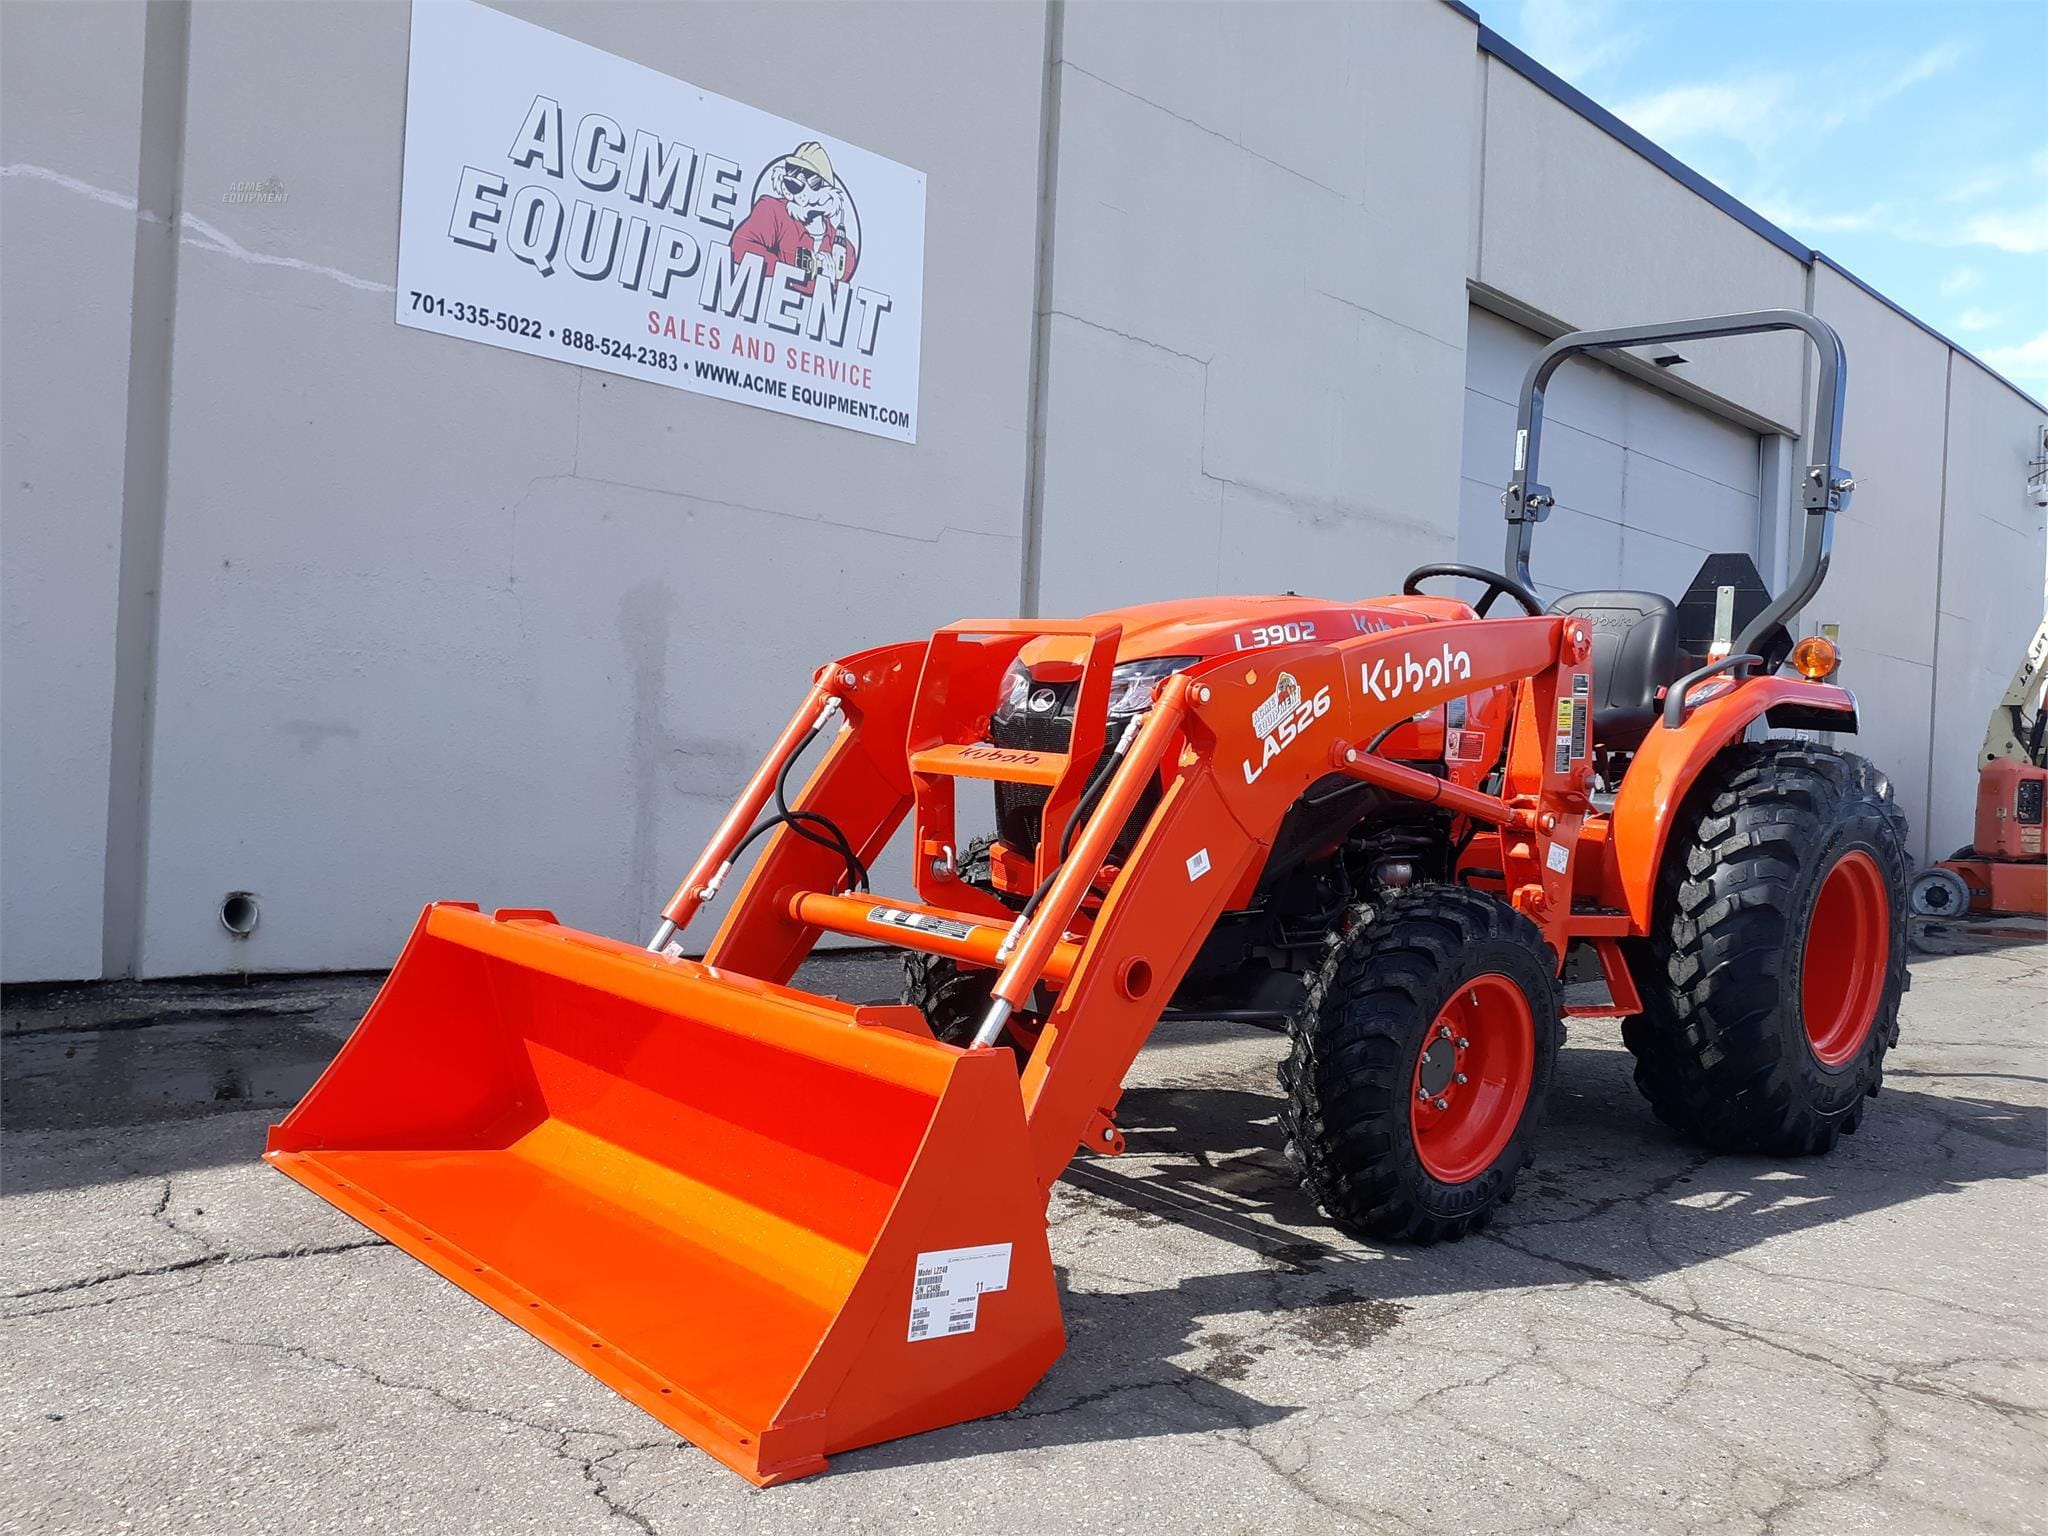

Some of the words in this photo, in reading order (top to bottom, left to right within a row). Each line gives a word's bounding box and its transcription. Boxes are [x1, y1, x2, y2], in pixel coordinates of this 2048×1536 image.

[508, 94, 742, 231] ACME
[448, 165, 892, 356] EQUIPMENT
[410, 291, 543, 340] 701-335-5022
[561, 327, 679, 373] 888-524-2383
[694, 359, 788, 400] WWW.ACME
[791, 385, 910, 429] EQUIPMENT.COM
[647, 310, 721, 351] SALES
[731, 333, 776, 365] AND
[786, 347, 873, 390] SERVICE
[1233, 621, 1317, 651] L3902
[1361, 642, 1472, 702] Kubota
[959, 747, 1040, 765] Kubota
[1242, 684, 1331, 786] LA526
[917, 1268, 932, 1277] Model
[976, 1281, 984, 1293] 11
